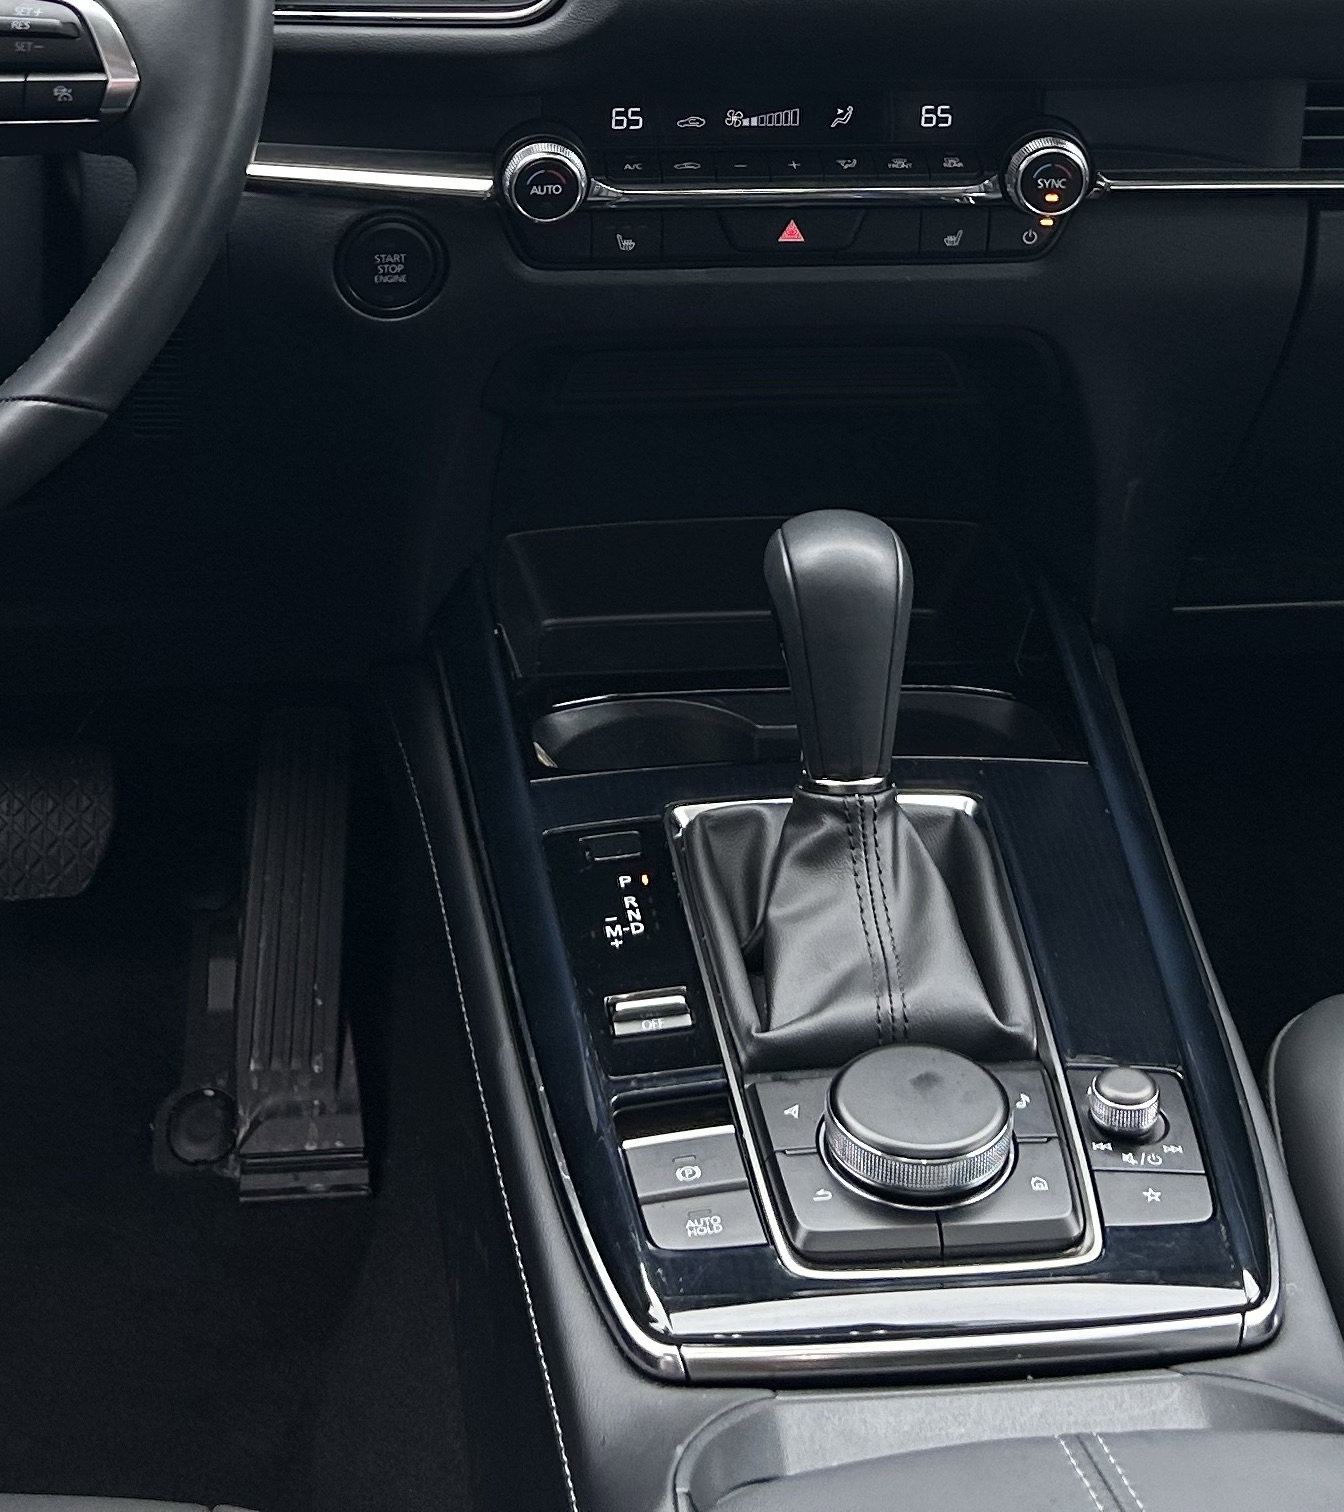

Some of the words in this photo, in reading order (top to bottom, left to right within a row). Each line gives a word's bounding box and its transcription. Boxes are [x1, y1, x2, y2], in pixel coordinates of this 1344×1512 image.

[10, 20, 31, 30] RES
[611, 107, 643, 130] 65
[920, 105, 953, 127] 65
[529, 184, 562, 196] AUTO
[1036, 178, 1067, 189] SYNC
[374, 254, 407, 263] START
[377, 264, 405, 273] STOP
[374, 275, 407, 283] ENGINE
[619, 875, 632, 888] P
[623, 896, 638, 909] R
[627, 908, 642, 921] N
[641, 1018, 665, 1031] OFF
[686, 1215, 722, 1229] AUTO
[687, 1224, 723, 1238] HOLD
